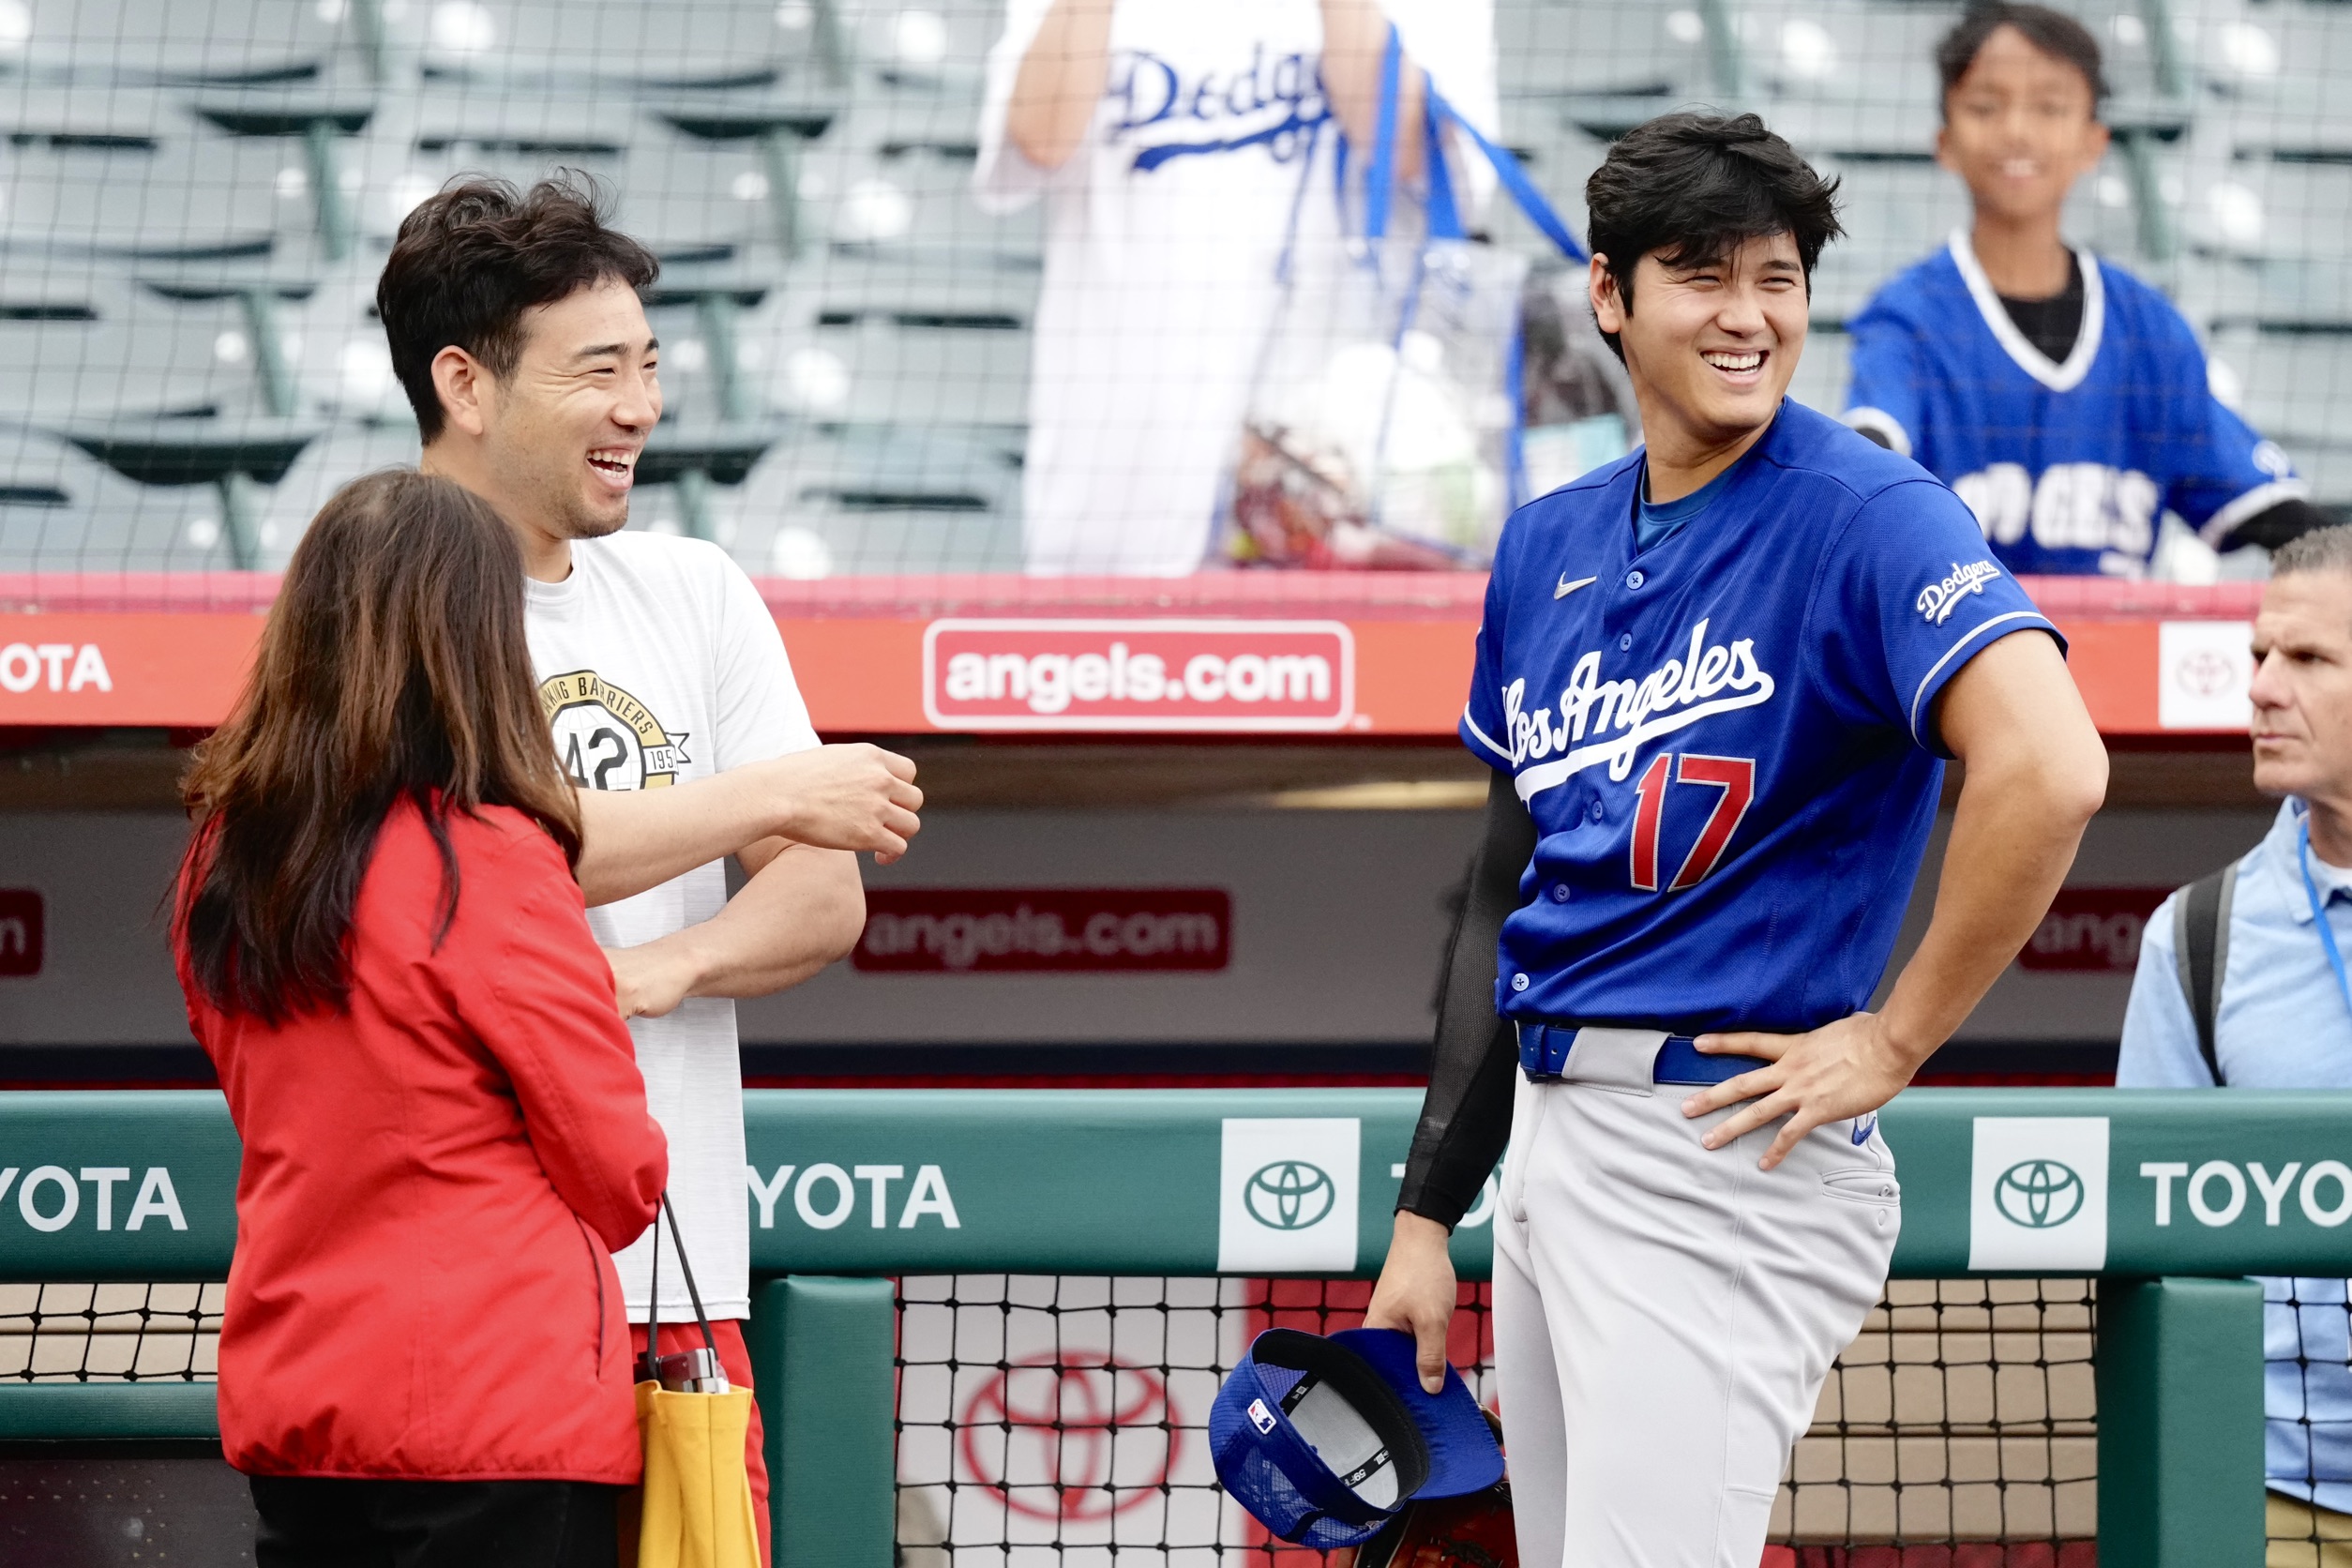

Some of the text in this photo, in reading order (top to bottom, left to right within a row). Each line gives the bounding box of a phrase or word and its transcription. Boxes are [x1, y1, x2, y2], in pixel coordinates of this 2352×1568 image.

[1917, 560, 2000, 625] Dodgers
[578, 676, 655, 734] BARRIERS
[944, 641, 1331, 715] angels.com
[1501, 617, 1775, 781] Los Angeles
[565, 727, 628, 791] 42
[1630, 752, 1756, 893] 17
[865, 903, 1218, 967] angels.com
[746, 1163, 961, 1229] YOTA
[2136, 1160, 2352, 1227] TOYO
